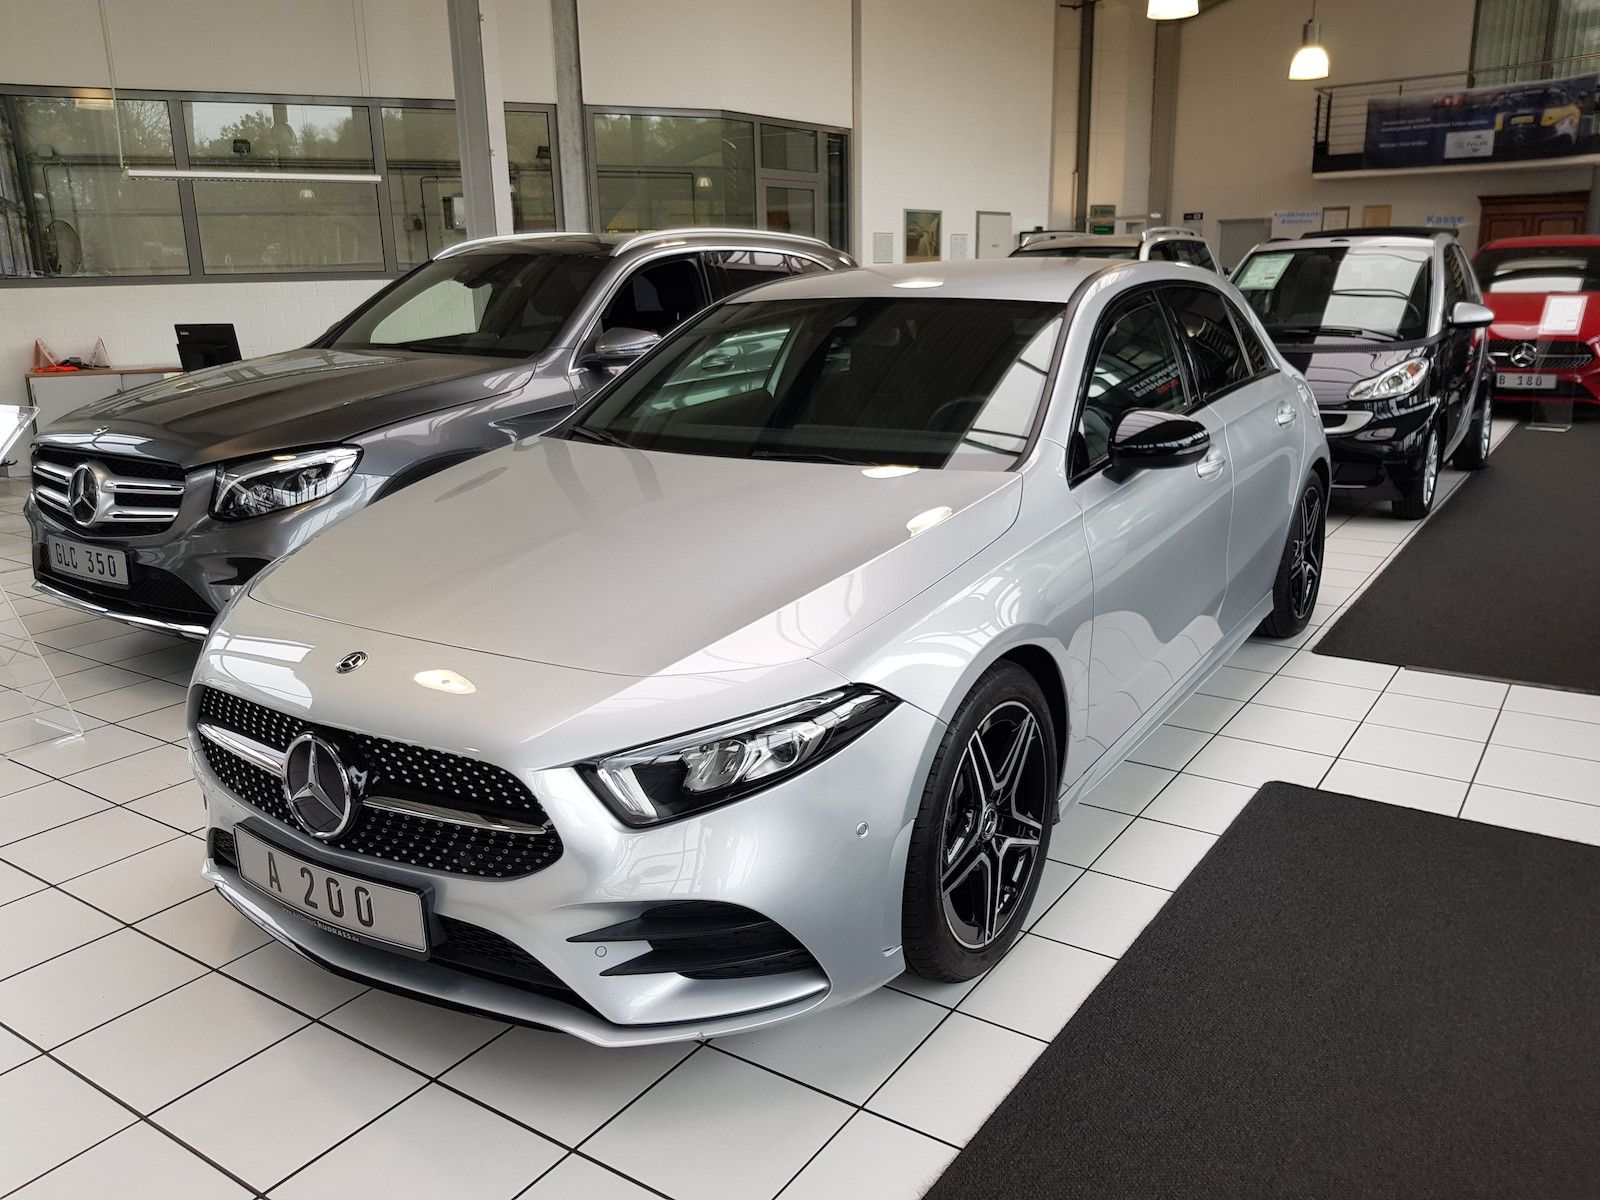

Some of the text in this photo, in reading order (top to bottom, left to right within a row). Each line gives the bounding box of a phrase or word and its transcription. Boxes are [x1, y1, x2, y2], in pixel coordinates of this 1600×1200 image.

[1426, 215, 1464, 224] Kasse
[1499, 374, 1543, 386] B 180
[55, 542, 78, 570] GLC
[85, 550, 117, 578] 350
[267, 851, 374, 928] A 200
